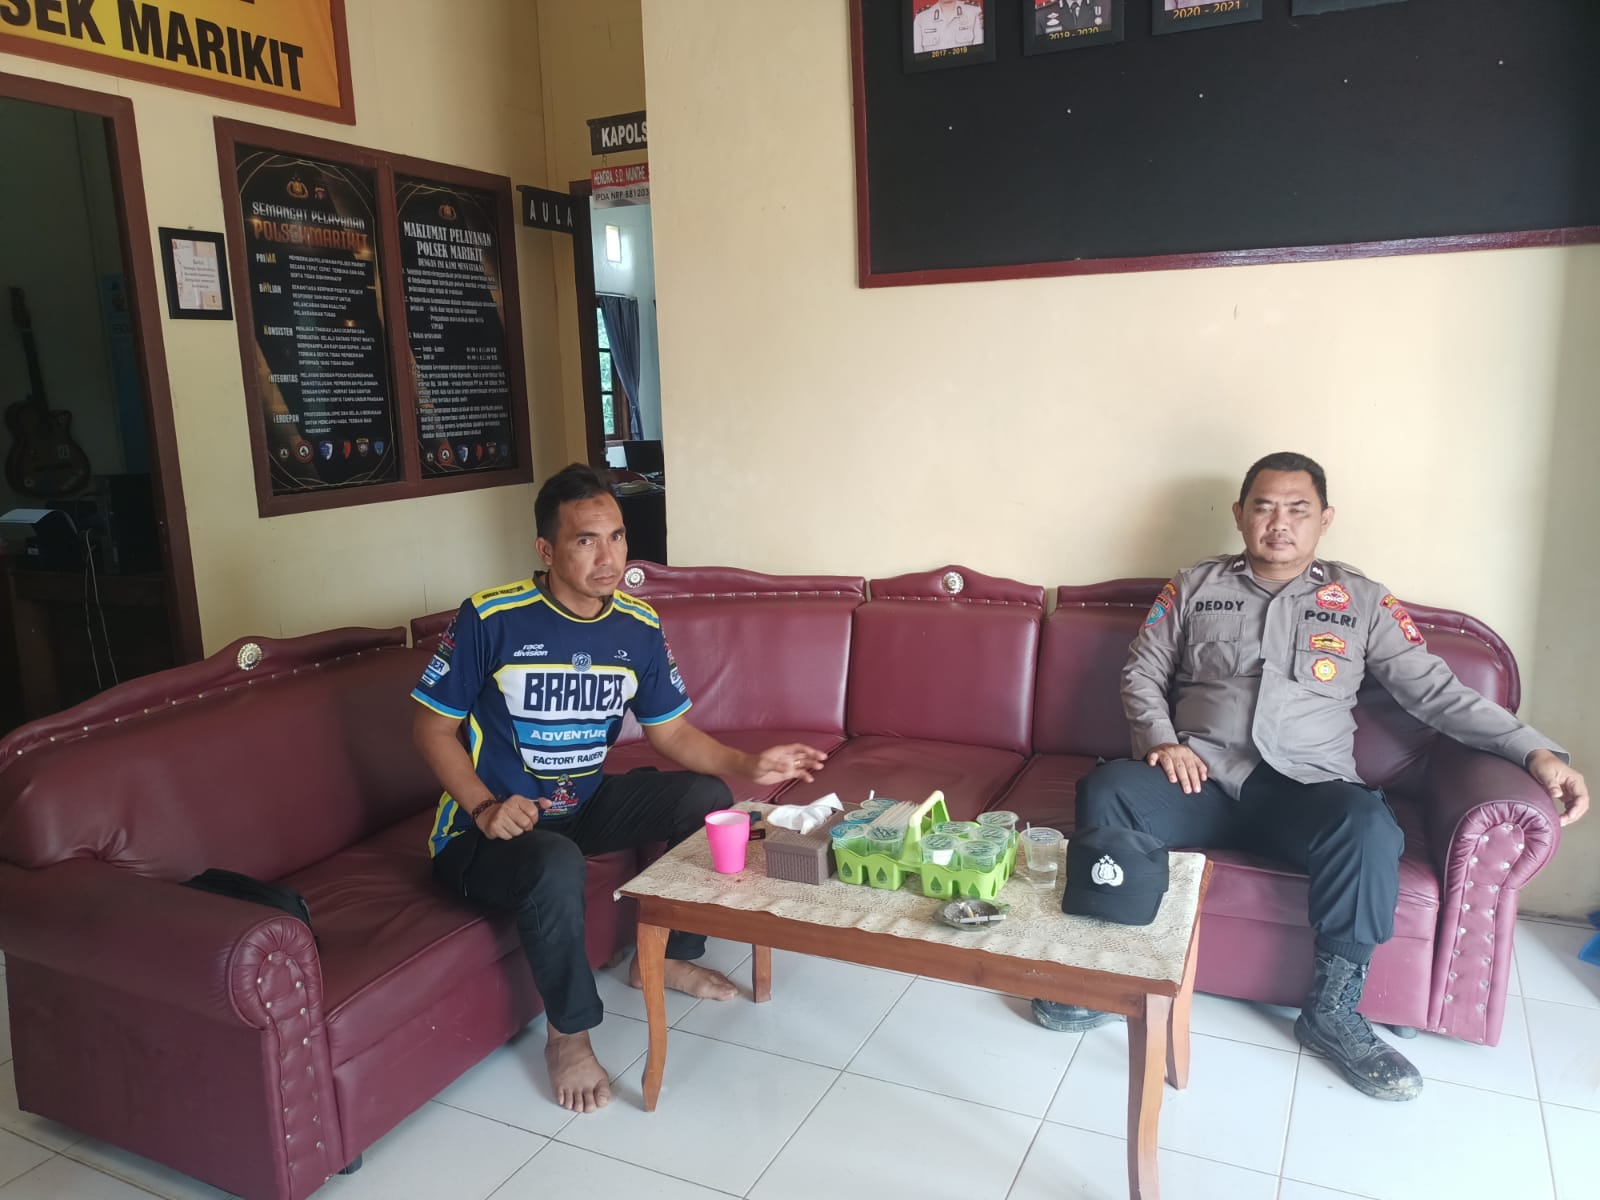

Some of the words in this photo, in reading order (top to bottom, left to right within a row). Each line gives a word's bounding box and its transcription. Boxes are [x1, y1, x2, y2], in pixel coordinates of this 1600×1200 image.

[116, 0, 303, 91] MARIKIT
[404, 221, 447, 241] MAKLUMAT
[450, 228, 492, 247] PELAYANAN
[416, 240, 448, 258] POLSEK
[450, 245, 483, 262] MARIKIT
[1195, 600, 1244, 612] DEDDY
[1304, 610, 1357, 628] POLRI
[532, 756, 575, 765] FACTORY
[578, 751, 604, 762] RAIDER
